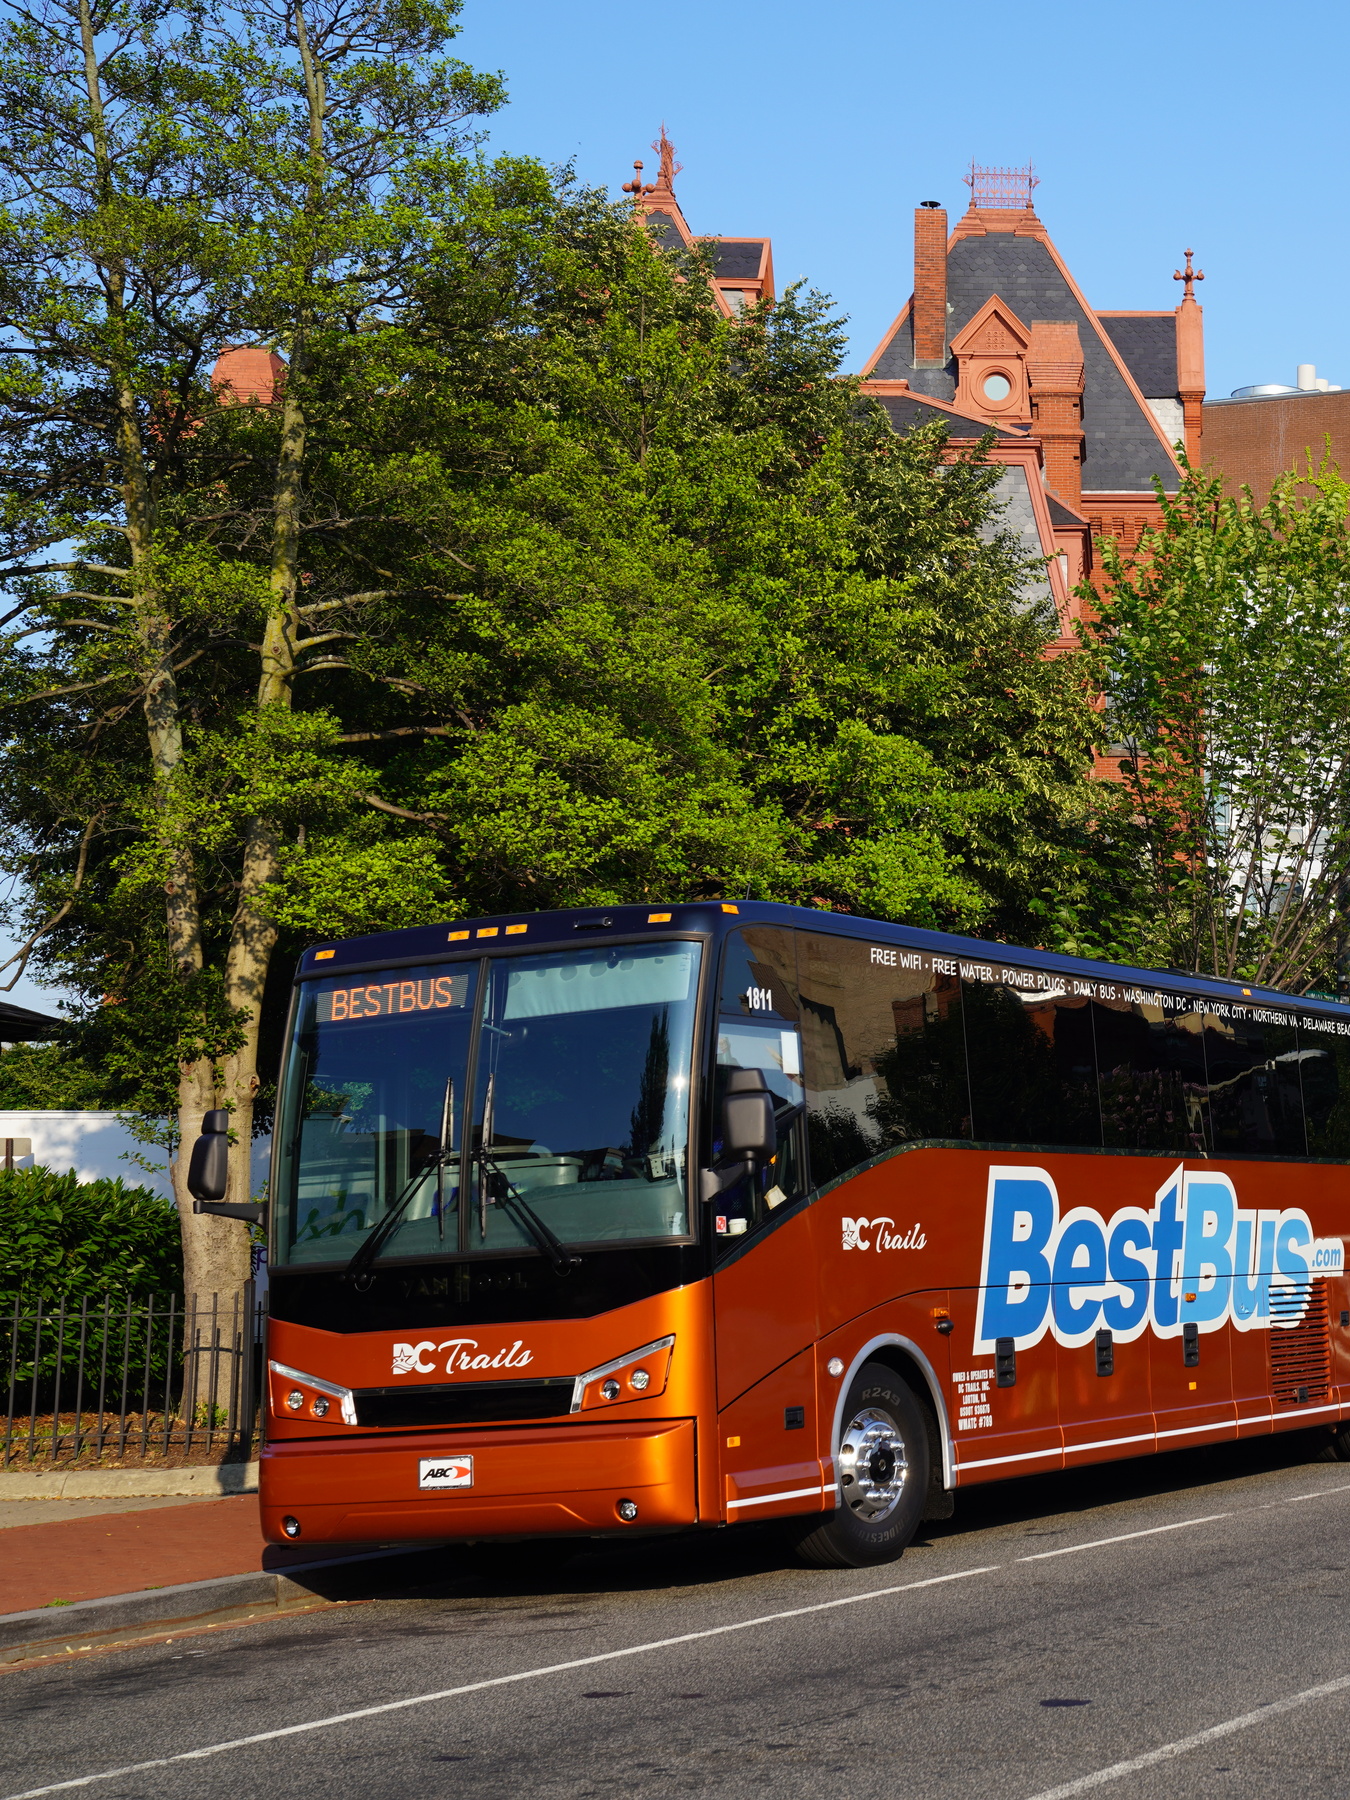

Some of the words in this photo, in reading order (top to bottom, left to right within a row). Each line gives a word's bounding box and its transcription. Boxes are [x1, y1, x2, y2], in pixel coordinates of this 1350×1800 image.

[331, 976, 453, 1021] BESTBUS
[746, 986, 772, 1011] 1811
[870, 947, 897, 967] FREE
[900, 952, 922, 970] WIFI
[932, 957, 957, 976] FREE
[959, 962, 994, 982] WATER
[1002, 969, 1035, 988] POWER
[1037, 974, 1066, 992] PLUGS
[1073, 980, 1098, 997] DAILY
[1099, 984, 1116, 1000] BUS
[1123, 988, 1174, 1009] WASHINGTON
[1176, 997, 1187, 1011] DC
[1193, 1000, 1210, 1014] NEW
[1210, 1002, 1231, 1018] YORK
[1231, 1006, 1247, 1020] CITY
[1252, 1009, 1287, 1026] NORTHERN
[1288, 1015, 1298, 1028] VA
[1303, 1017, 1336, 1034] DELAWARE
[841, 1216, 870, 1251] DC
[870, 1216, 927, 1253] Trails
[391, 1341, 436, 1375] DC
[438, 1338, 534, 1375] Trails
[862, 1386, 900, 1407] R249
[422, 1467, 453, 1481] ABC
